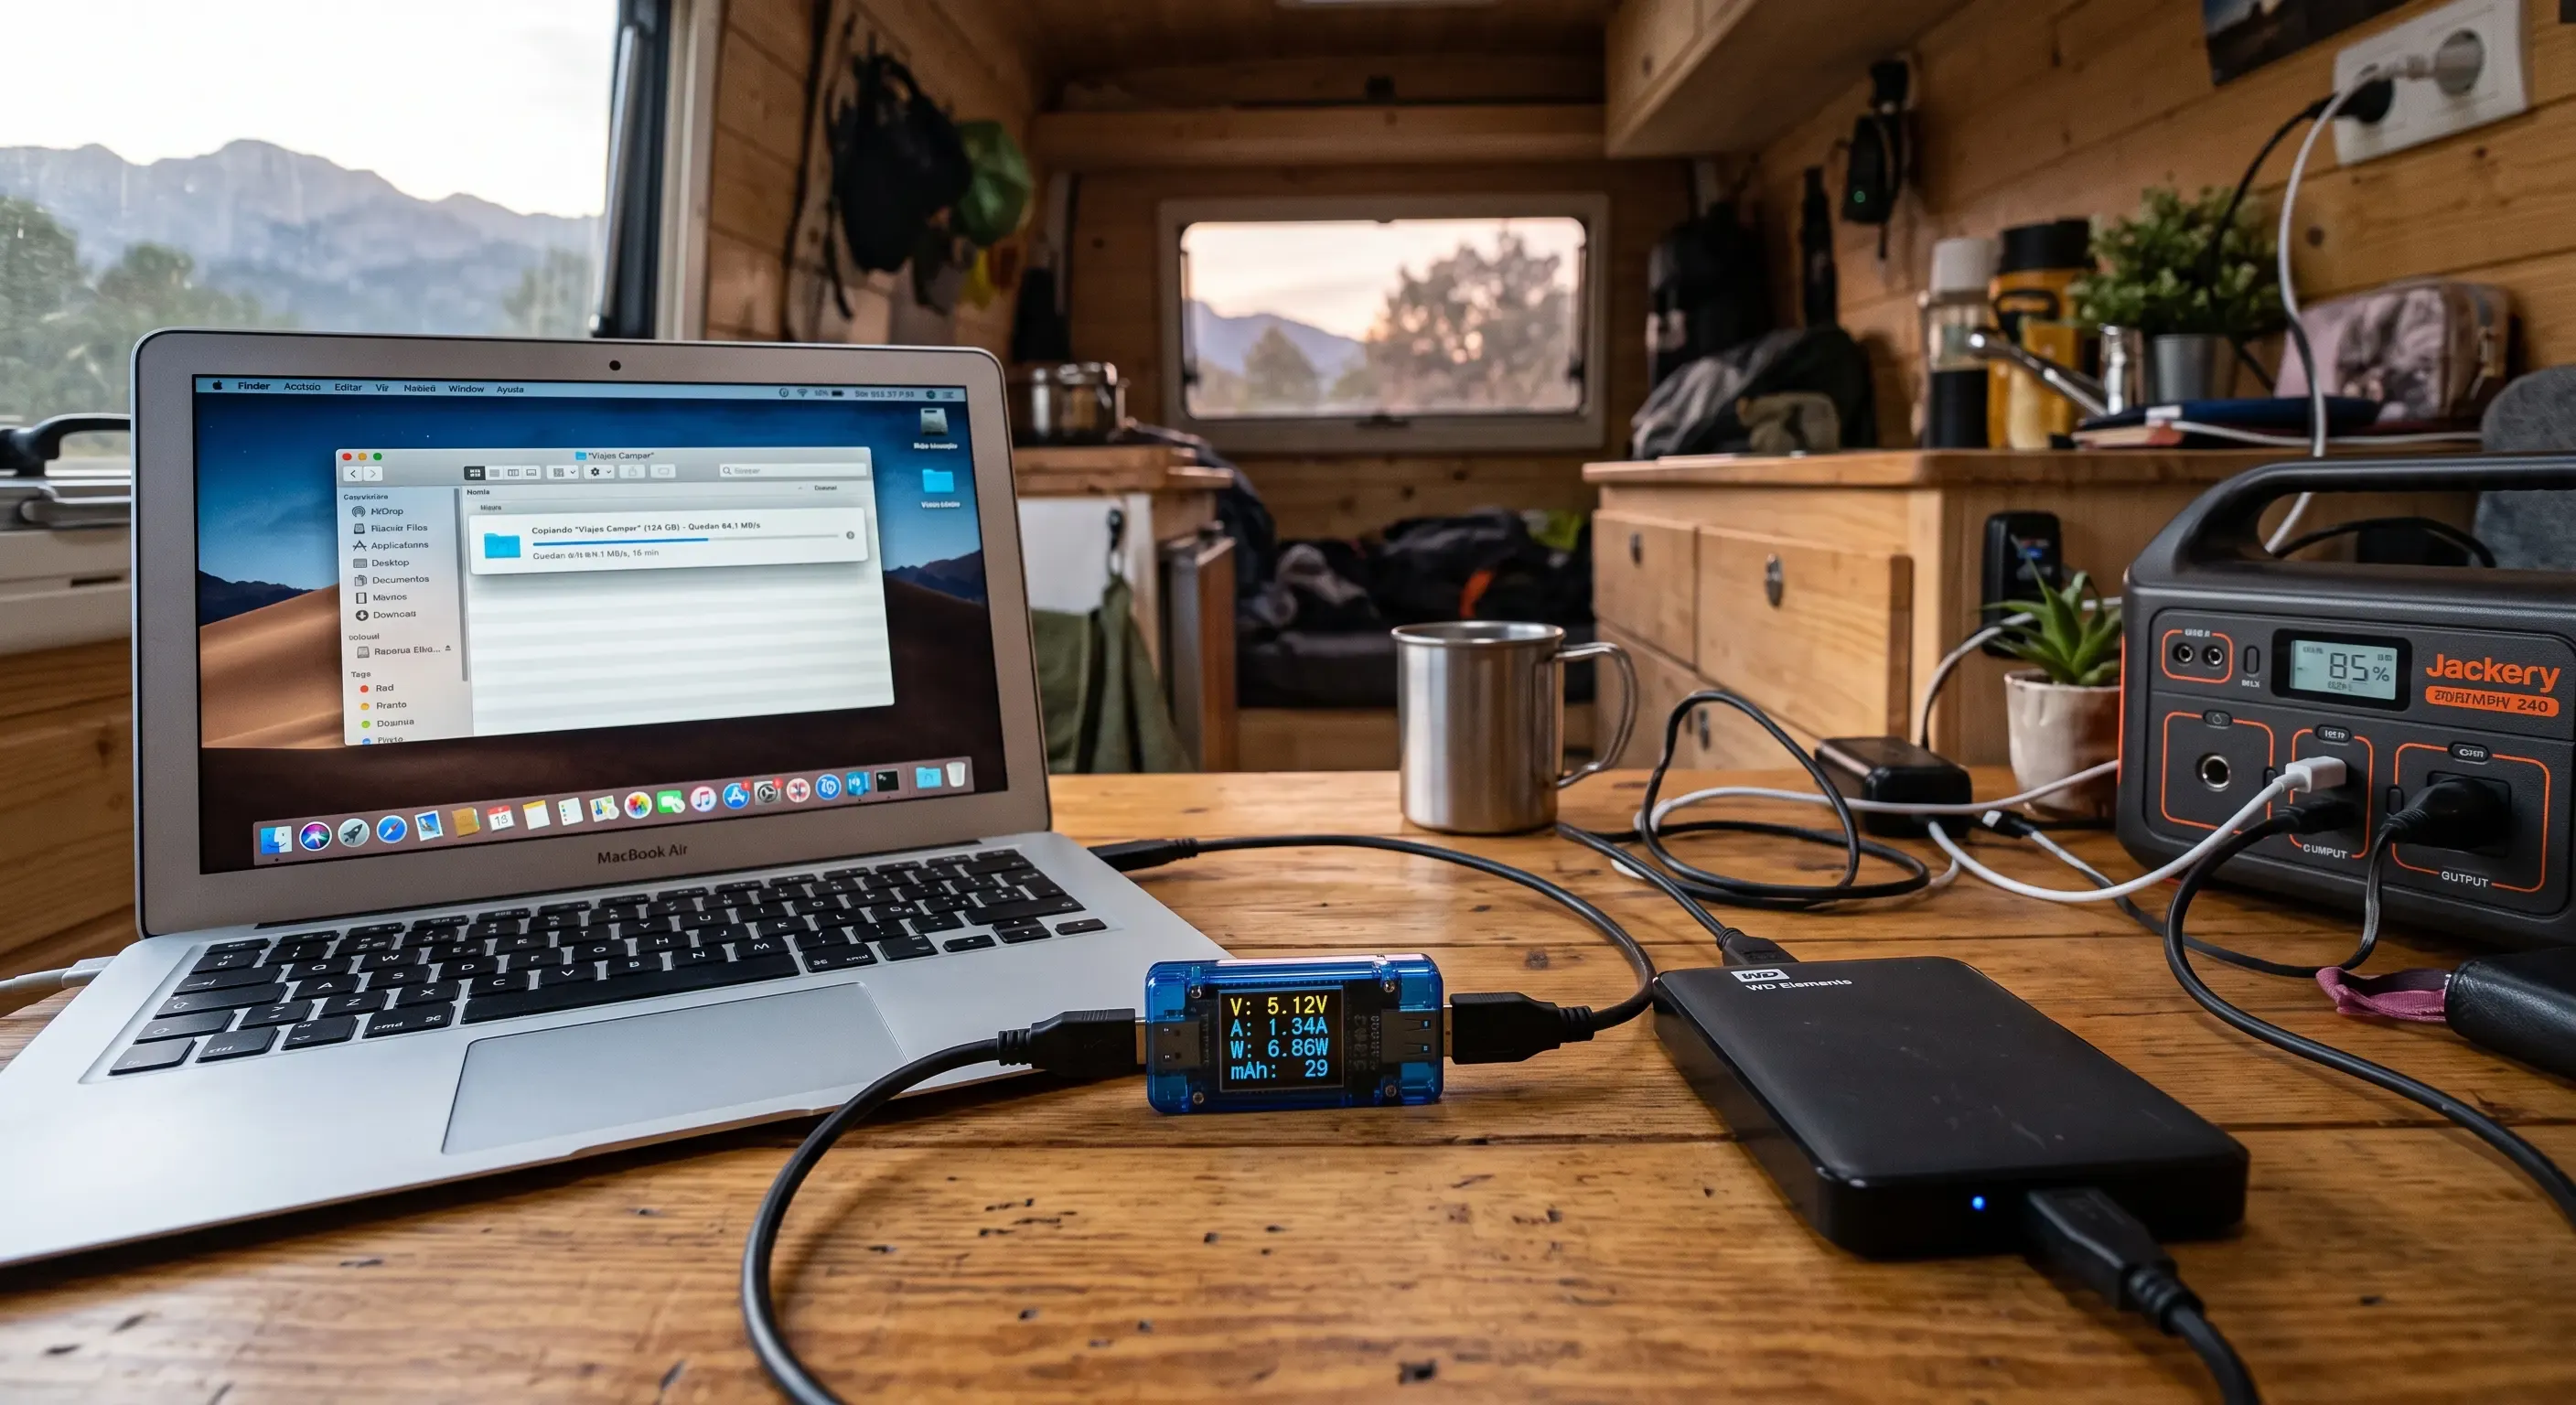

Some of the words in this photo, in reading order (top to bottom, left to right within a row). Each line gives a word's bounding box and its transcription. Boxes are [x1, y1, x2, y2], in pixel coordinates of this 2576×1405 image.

[237, 381, 271, 391] Finder
[334, 383, 363, 391] Editar
[448, 385, 485, 393] Window
[531, 526, 573, 536] Copiando
[688, 522, 720, 531] Quedan
[371, 559, 410, 568] Desktop
[350, 670, 371, 679] Tags
[2425, 653, 2561, 693] Jackery
[2517, 698, 2549, 713] 240
[597, 845, 666, 865] MacBook
[317, 981, 333, 991] A
[420, 988, 435, 996] X
[1745, 983, 1776, 992] WD
[346, 998, 361, 1006] Z
[1229, 997, 1251, 1016] V:
[1267, 994, 1328, 1015] 5.12V
[1229, 1018, 1251, 1037] A:
[1269, 1016, 1328, 1036] 1.34A
[1229, 1040, 1252, 1059] W:
[1267, 1037, 1329, 1057] 6.86W
[1230, 1061, 1276, 1080] mAh:
[1304, 1058, 1328, 1078] 29
